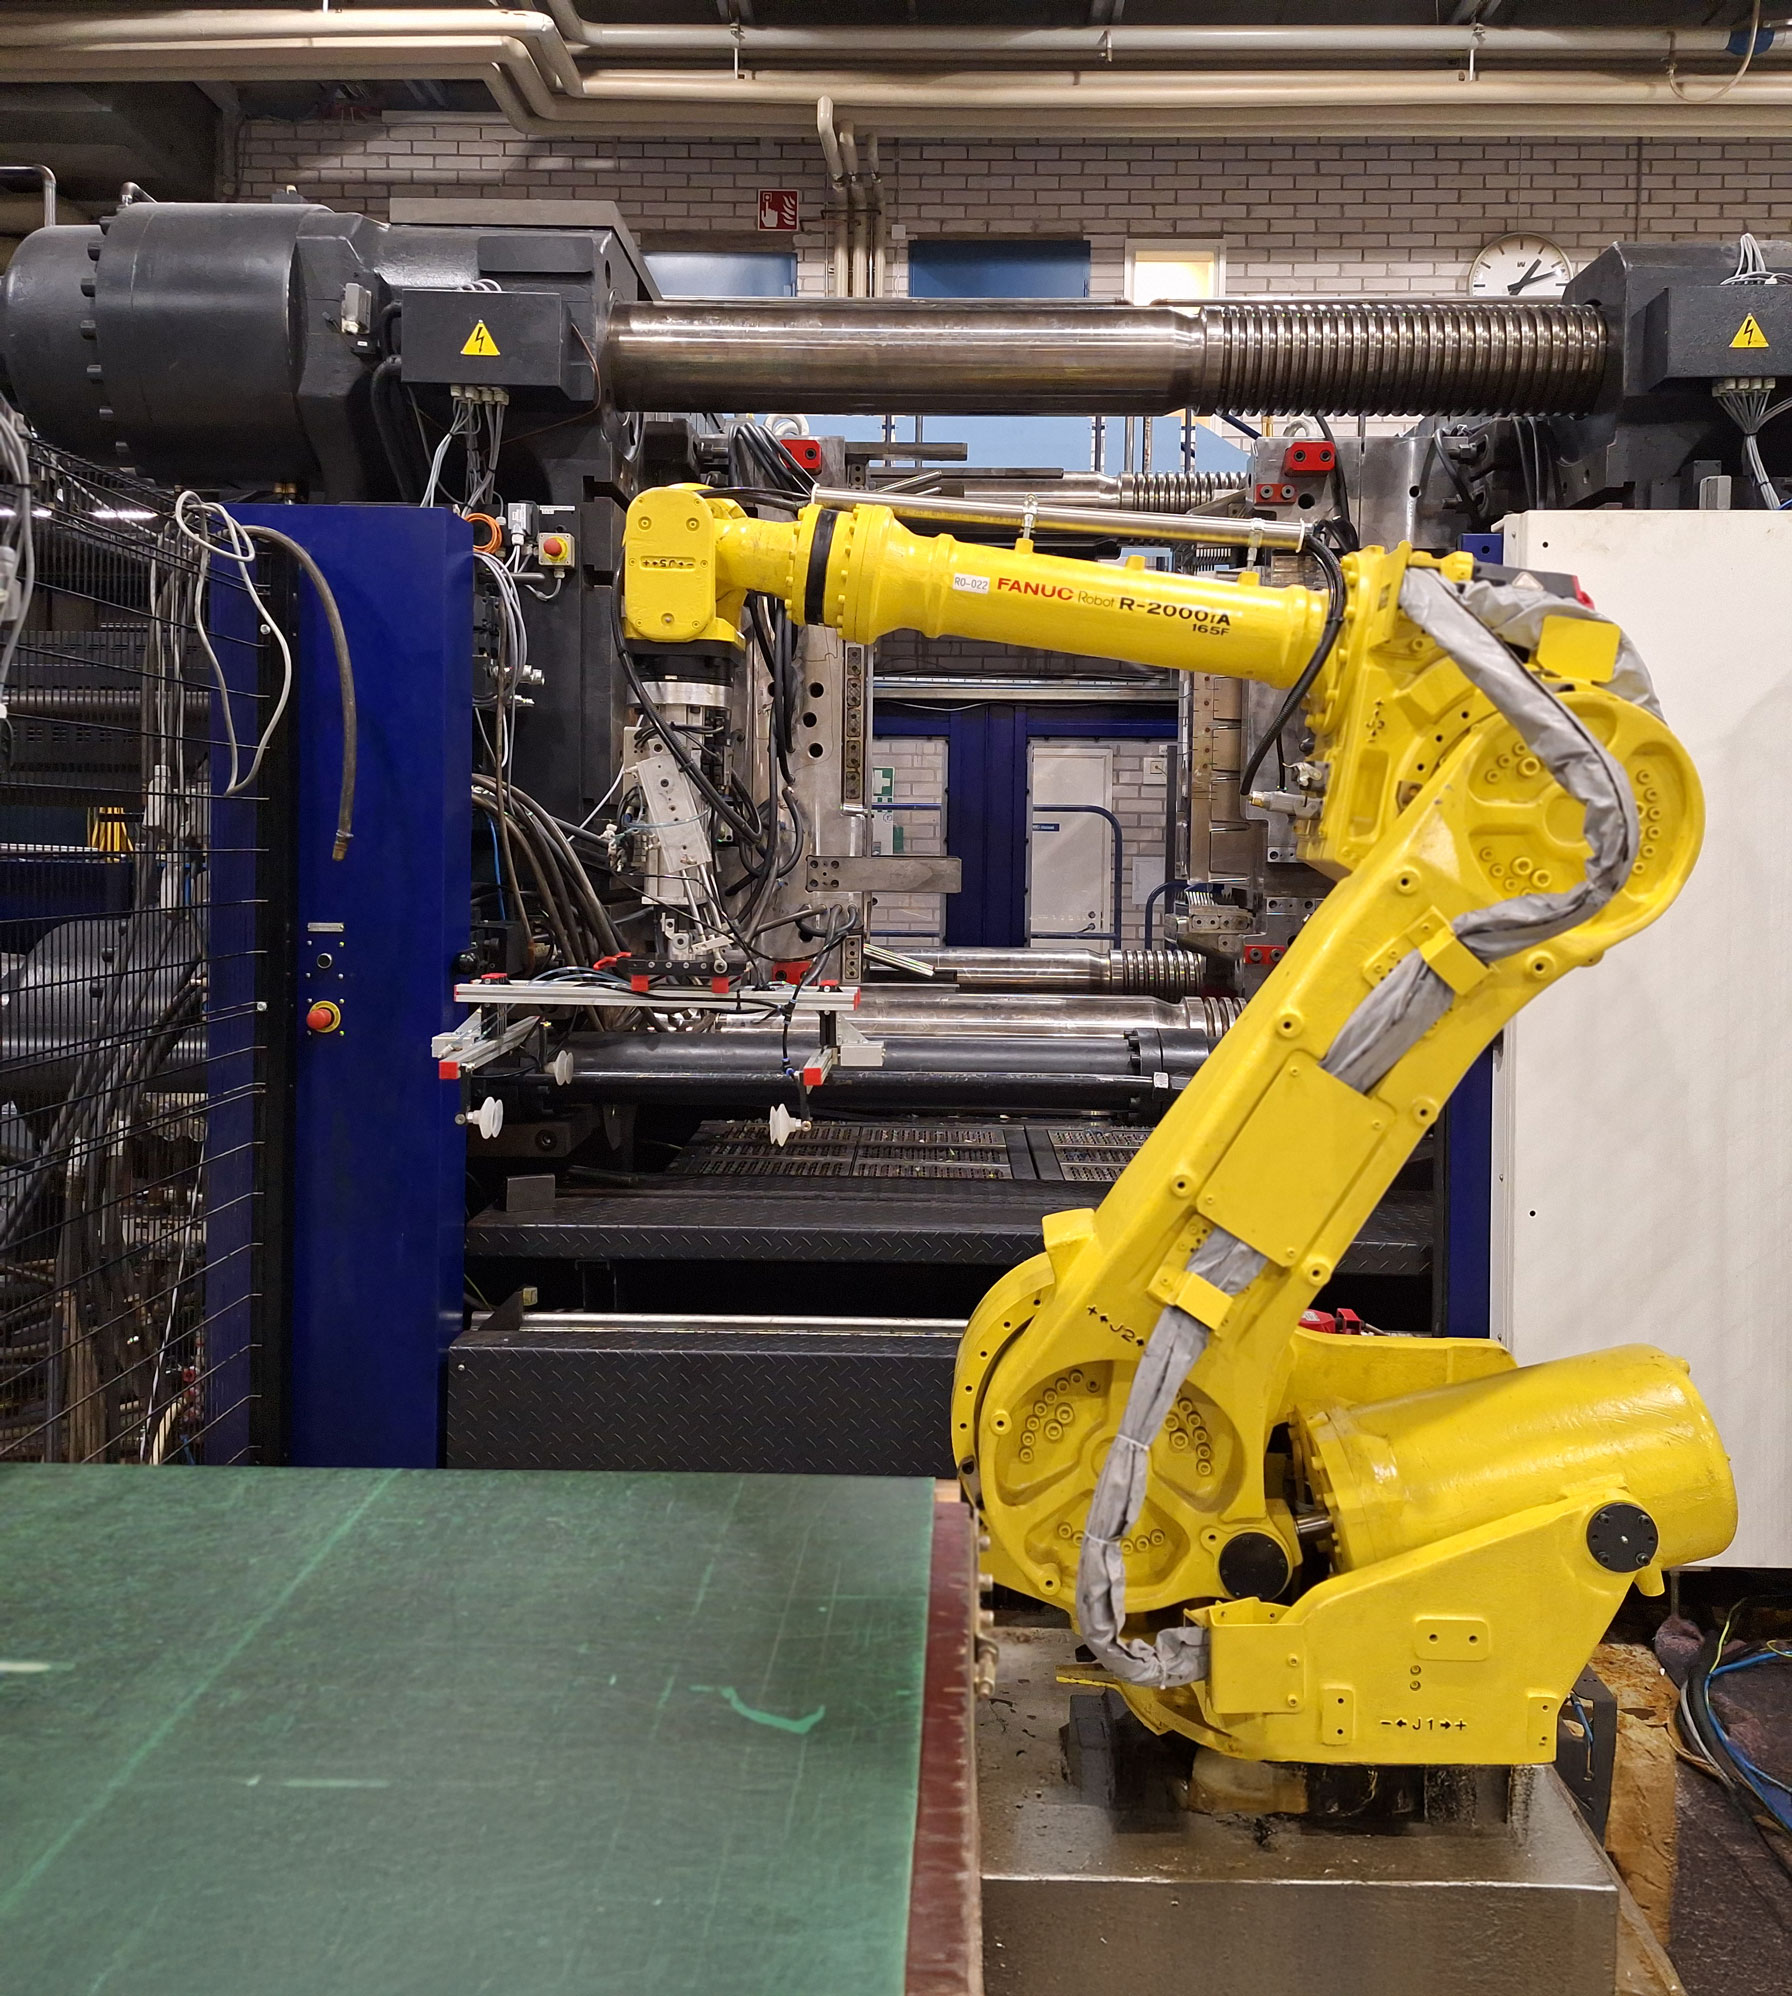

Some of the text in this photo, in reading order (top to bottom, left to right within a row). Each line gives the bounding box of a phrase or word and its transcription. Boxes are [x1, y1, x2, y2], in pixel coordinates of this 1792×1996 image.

[997, 577, 1074, 601] FANUC
[1077, 590, 1114, 608] Robot
[1192, 623, 1231, 636] 165F
